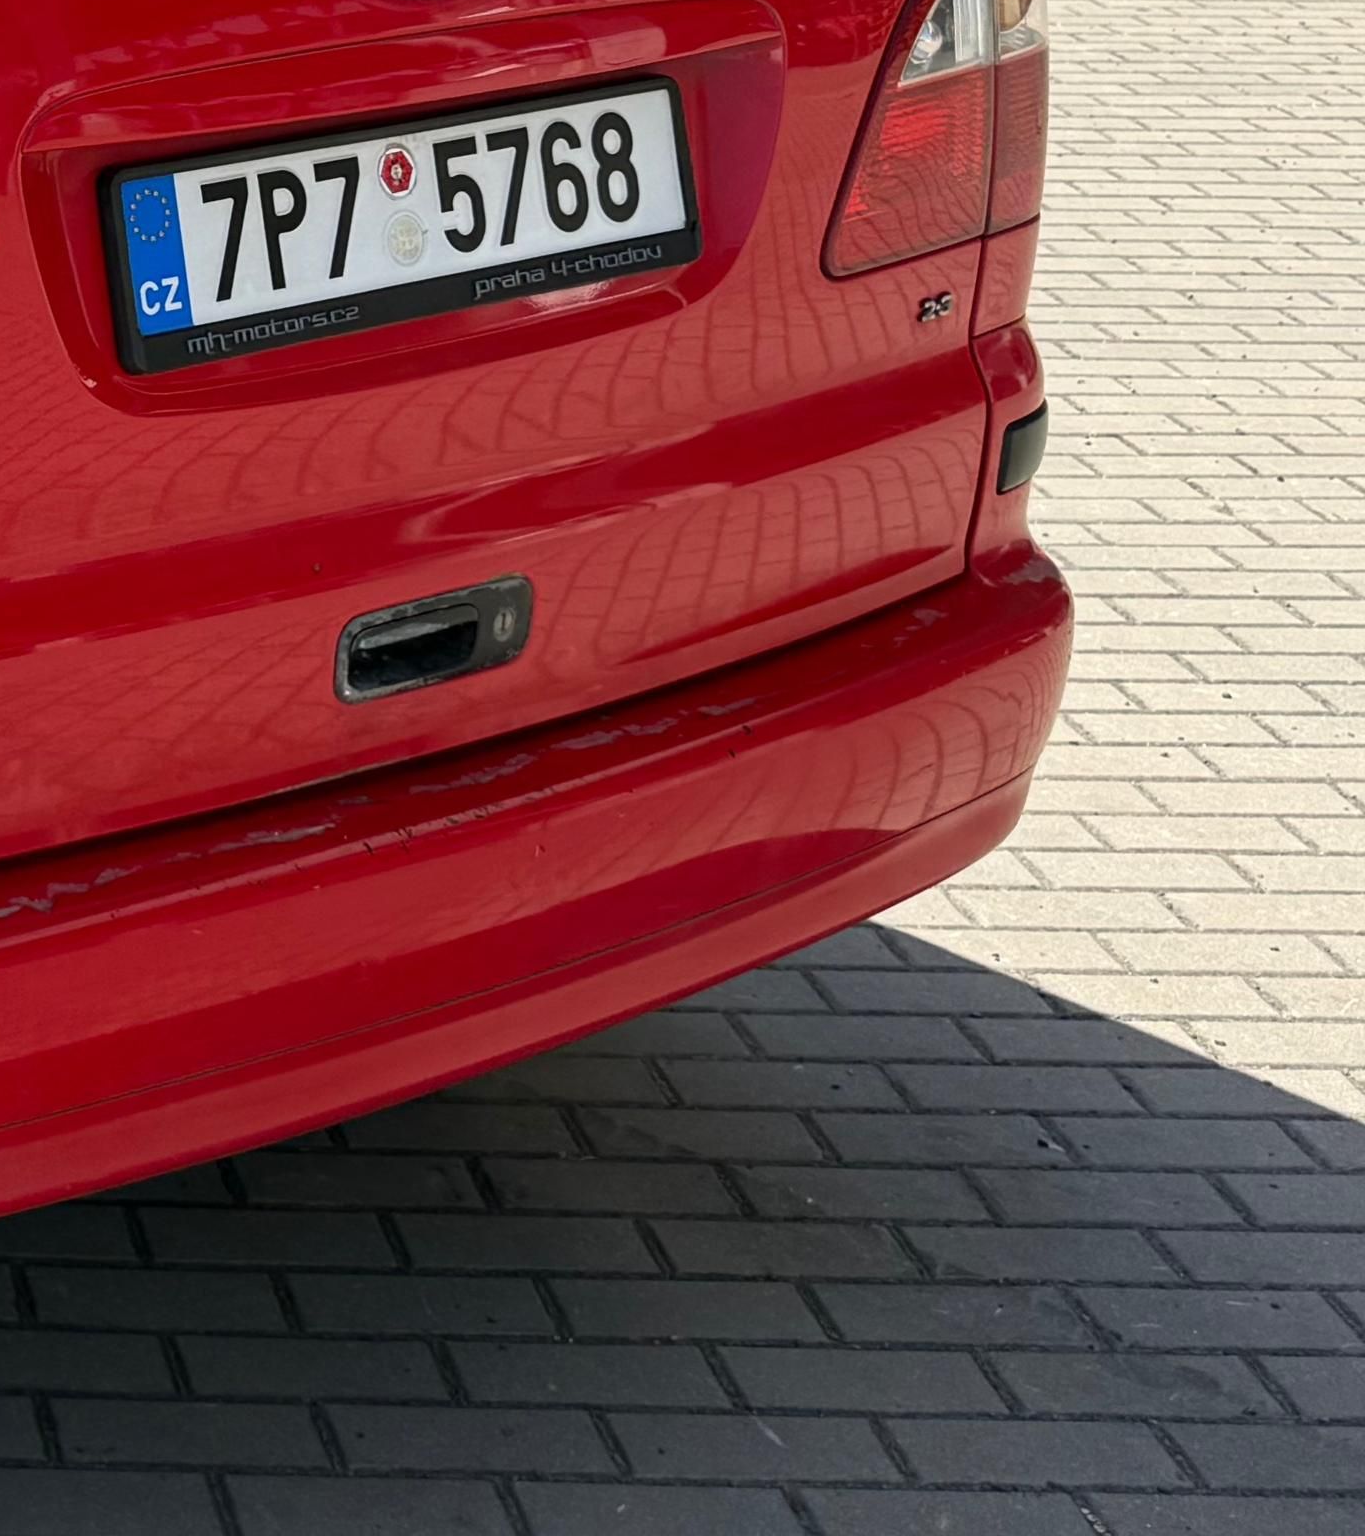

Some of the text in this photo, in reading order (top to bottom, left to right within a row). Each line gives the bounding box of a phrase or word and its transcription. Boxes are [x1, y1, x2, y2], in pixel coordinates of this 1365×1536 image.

[200, 111, 641, 303] 7P7 5768
[139, 276, 183, 317] CZ
[473, 245, 662, 301] praha 4-chodov
[187, 305, 360, 355] mh-motors.cz
